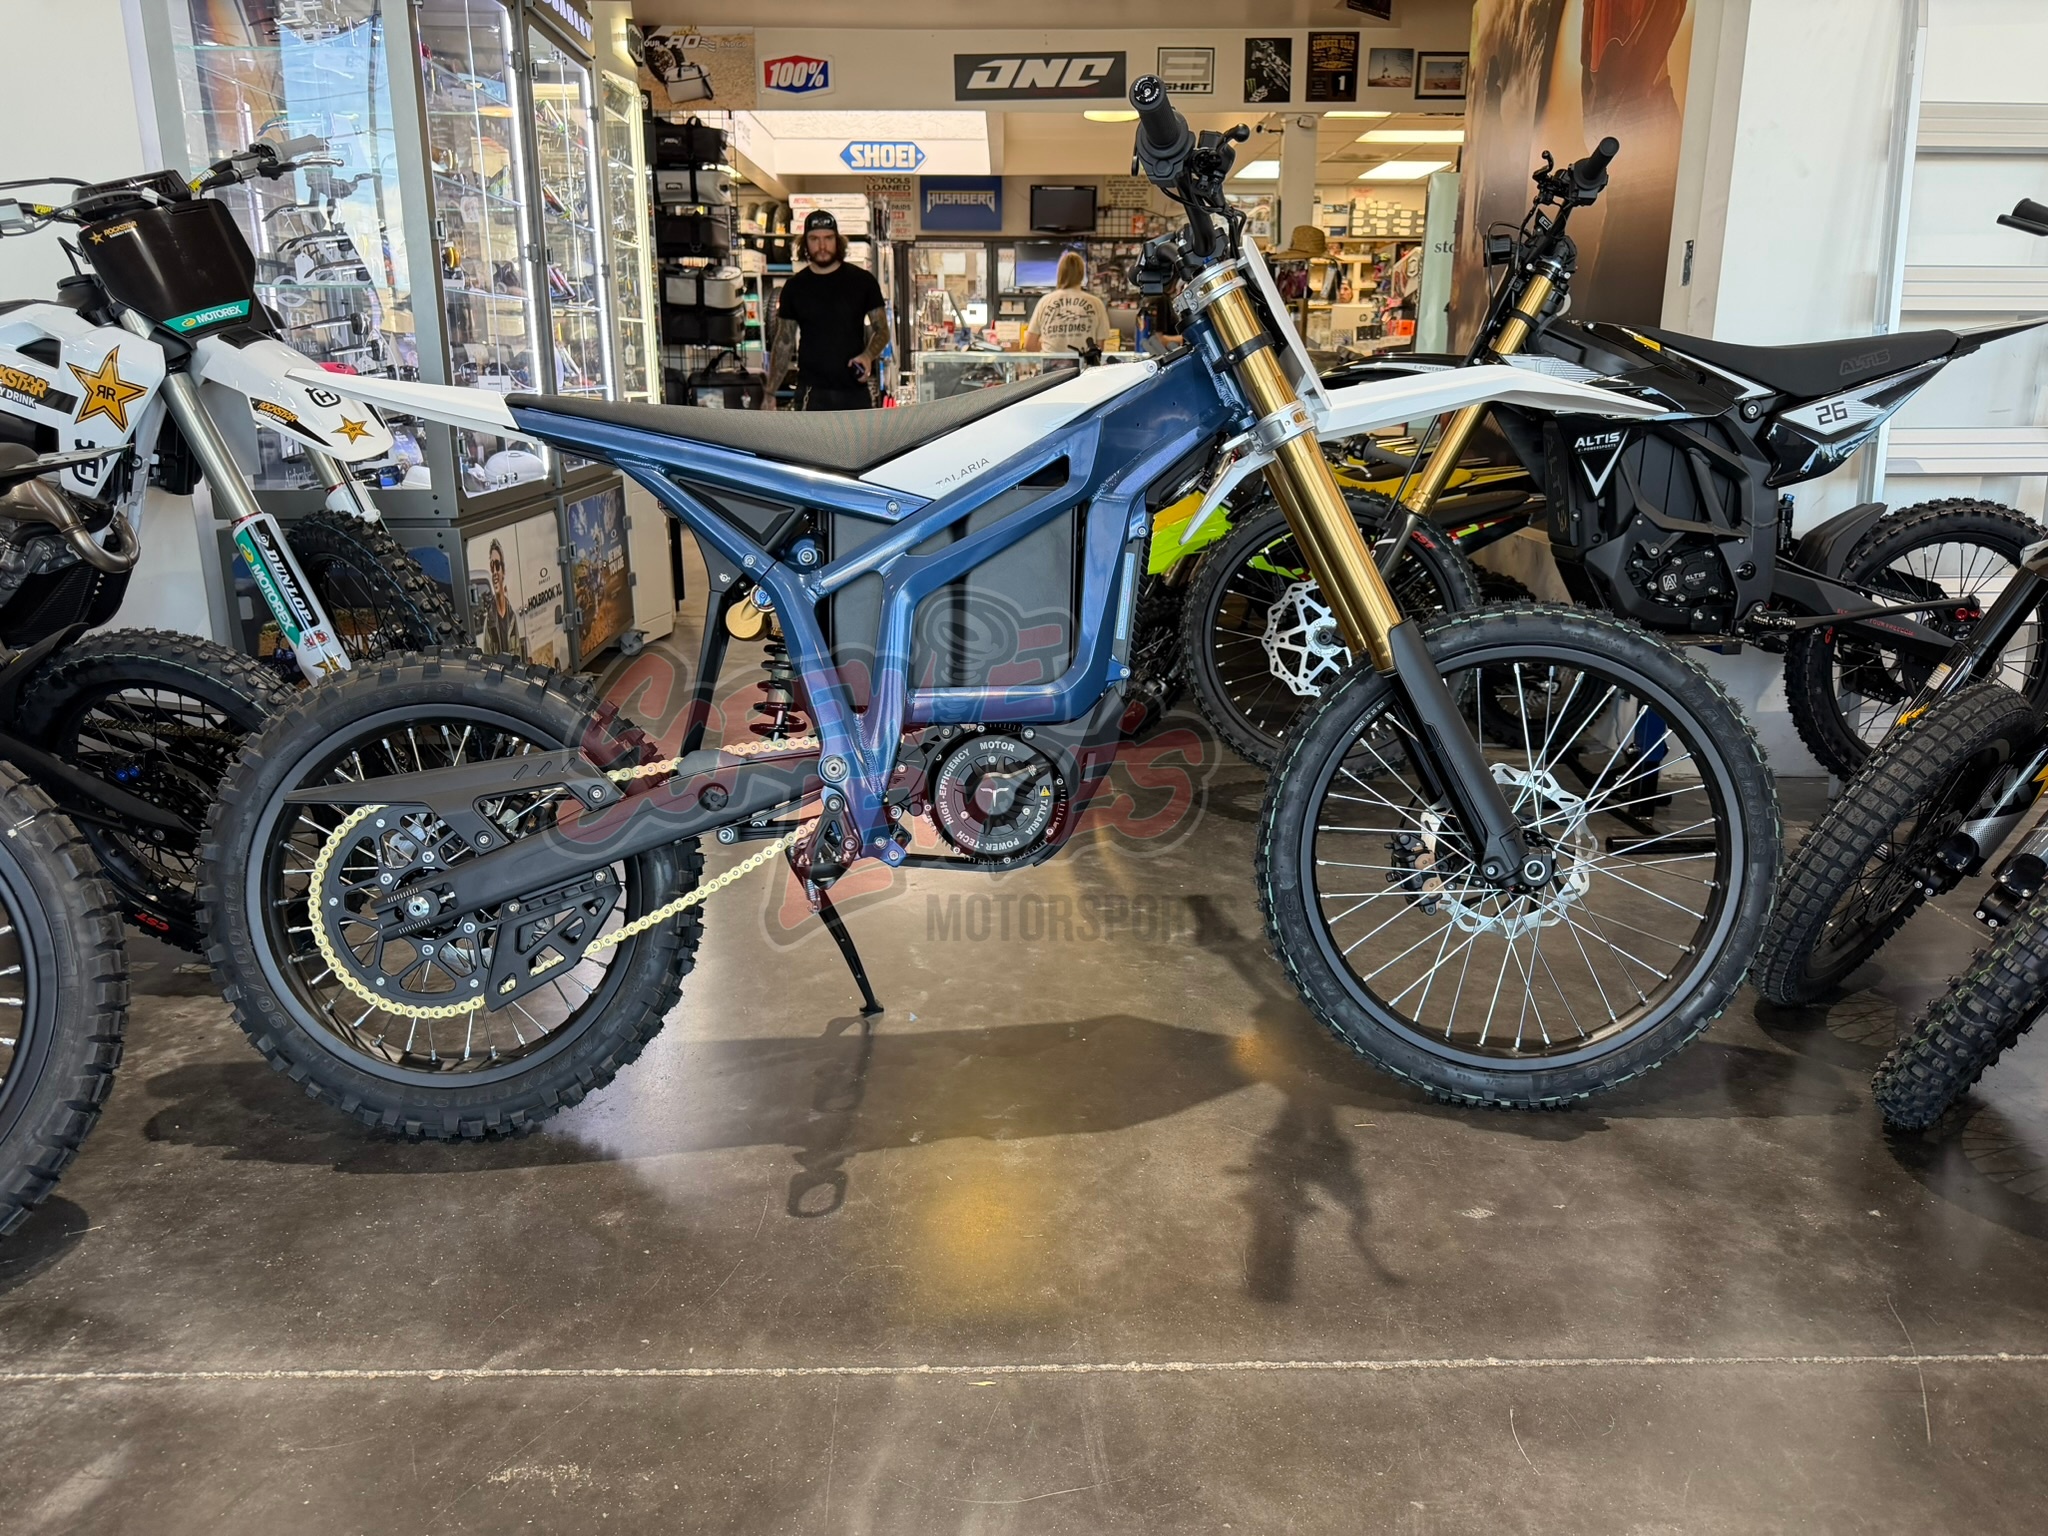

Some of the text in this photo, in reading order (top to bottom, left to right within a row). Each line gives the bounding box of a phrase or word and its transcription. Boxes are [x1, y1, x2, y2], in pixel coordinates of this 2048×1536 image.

[769, 61, 825, 88] 100%
[1164, 82, 1211, 91] SHIFT
[849, 143, 917, 168] SHOEI
[926, 190, 996, 213] HUSABERG
[103, 220, 138, 236] ROCKSTAR
[196, 305, 243, 325] MOTOREX
[1047, 323, 1086, 335] CUSTOMS
[1840, 349, 1890, 376] ALTIS
[6, 390, 36, 408] DRINK
[257, 401, 299, 422] ROCKSTAR
[1815, 400, 1848, 426] 26
[1574, 431, 1621, 448] ALTIS
[935, 457, 990, 489] TALARIA
[267, 549, 314, 623] DUNLOP
[1685, 571, 1706, 581] ALTIS
[250, 563, 295, 632] MOTOREX
[527, 587, 556, 611] HOLBROOK
[979, 741, 1015, 752] MOTOR
[1025, 798, 1049, 836] TALARIA
[134, 912, 170, 931] CST
